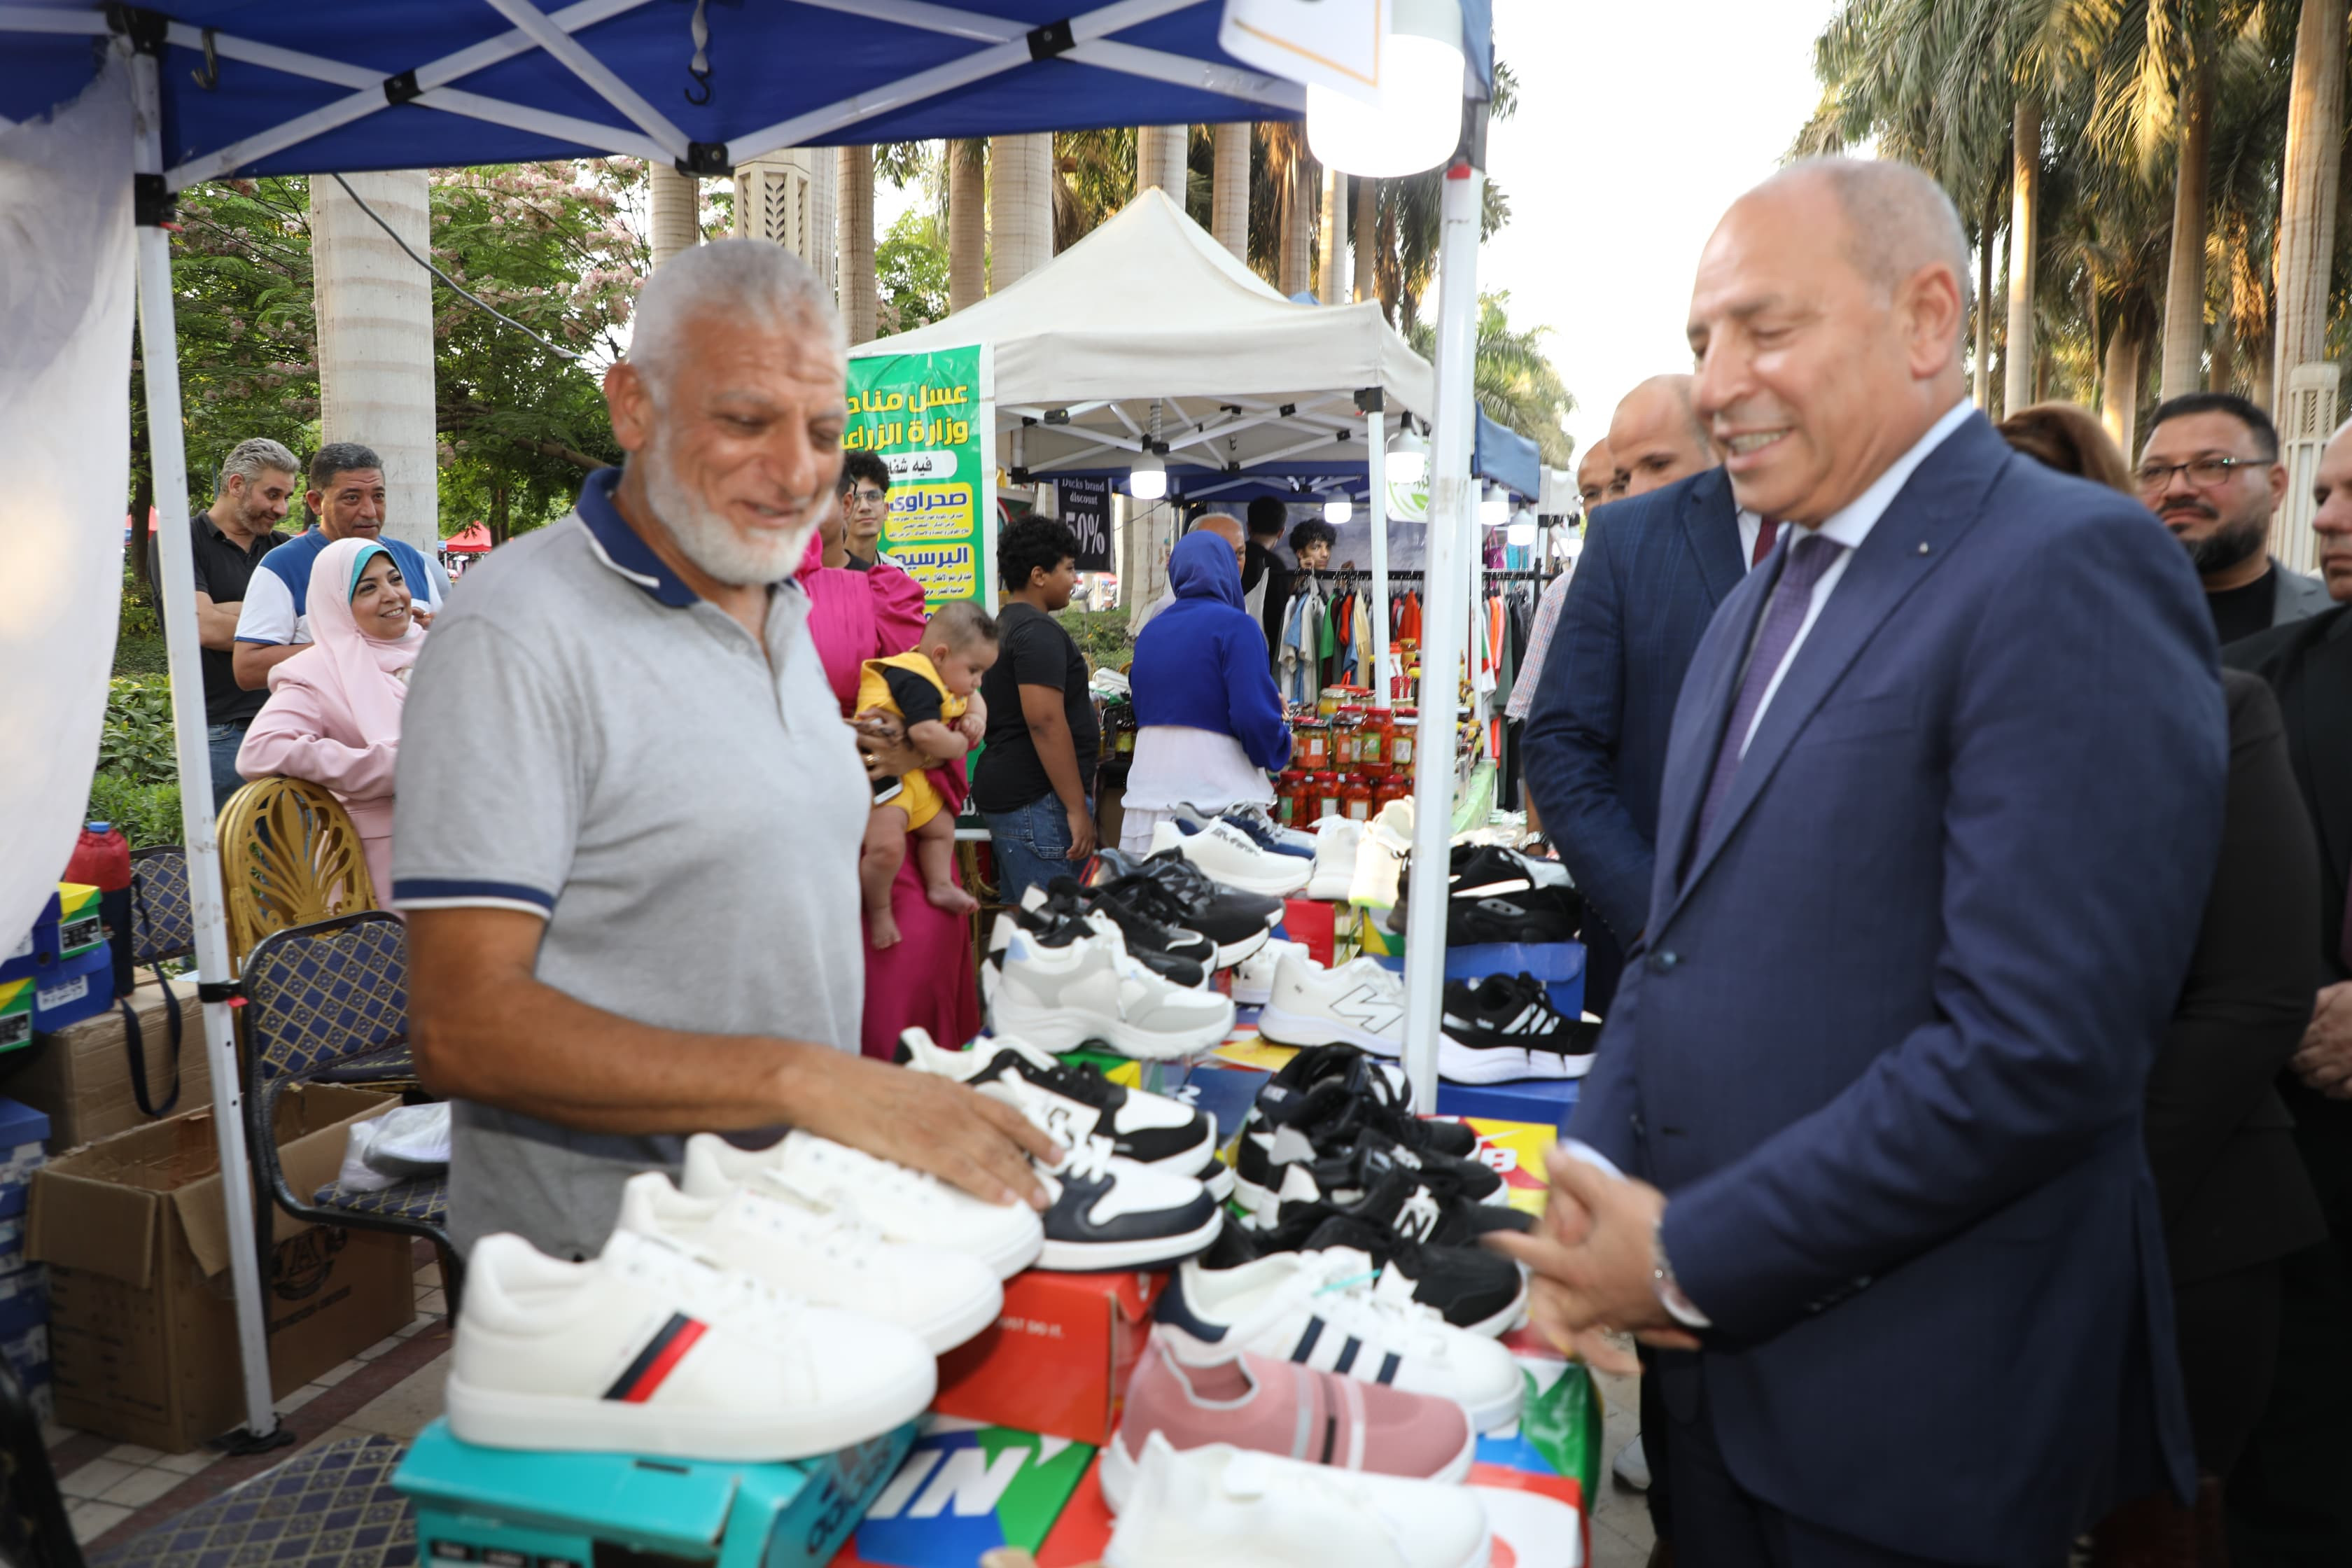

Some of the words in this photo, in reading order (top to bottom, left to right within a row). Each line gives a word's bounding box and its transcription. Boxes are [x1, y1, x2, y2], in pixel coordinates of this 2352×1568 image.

[845, 389, 904, 415] مناح
[908, 384, 968, 413] عسل
[841, 421, 903, 451] الزراع
[907, 417, 969, 447] وزارة
[888, 457, 908, 475] شفا
[912, 456, 932, 476] فيه
[1062, 477, 1084, 489] Ducks
[1085, 479, 1105, 493] brand
[1070, 491, 1098, 505] discount
